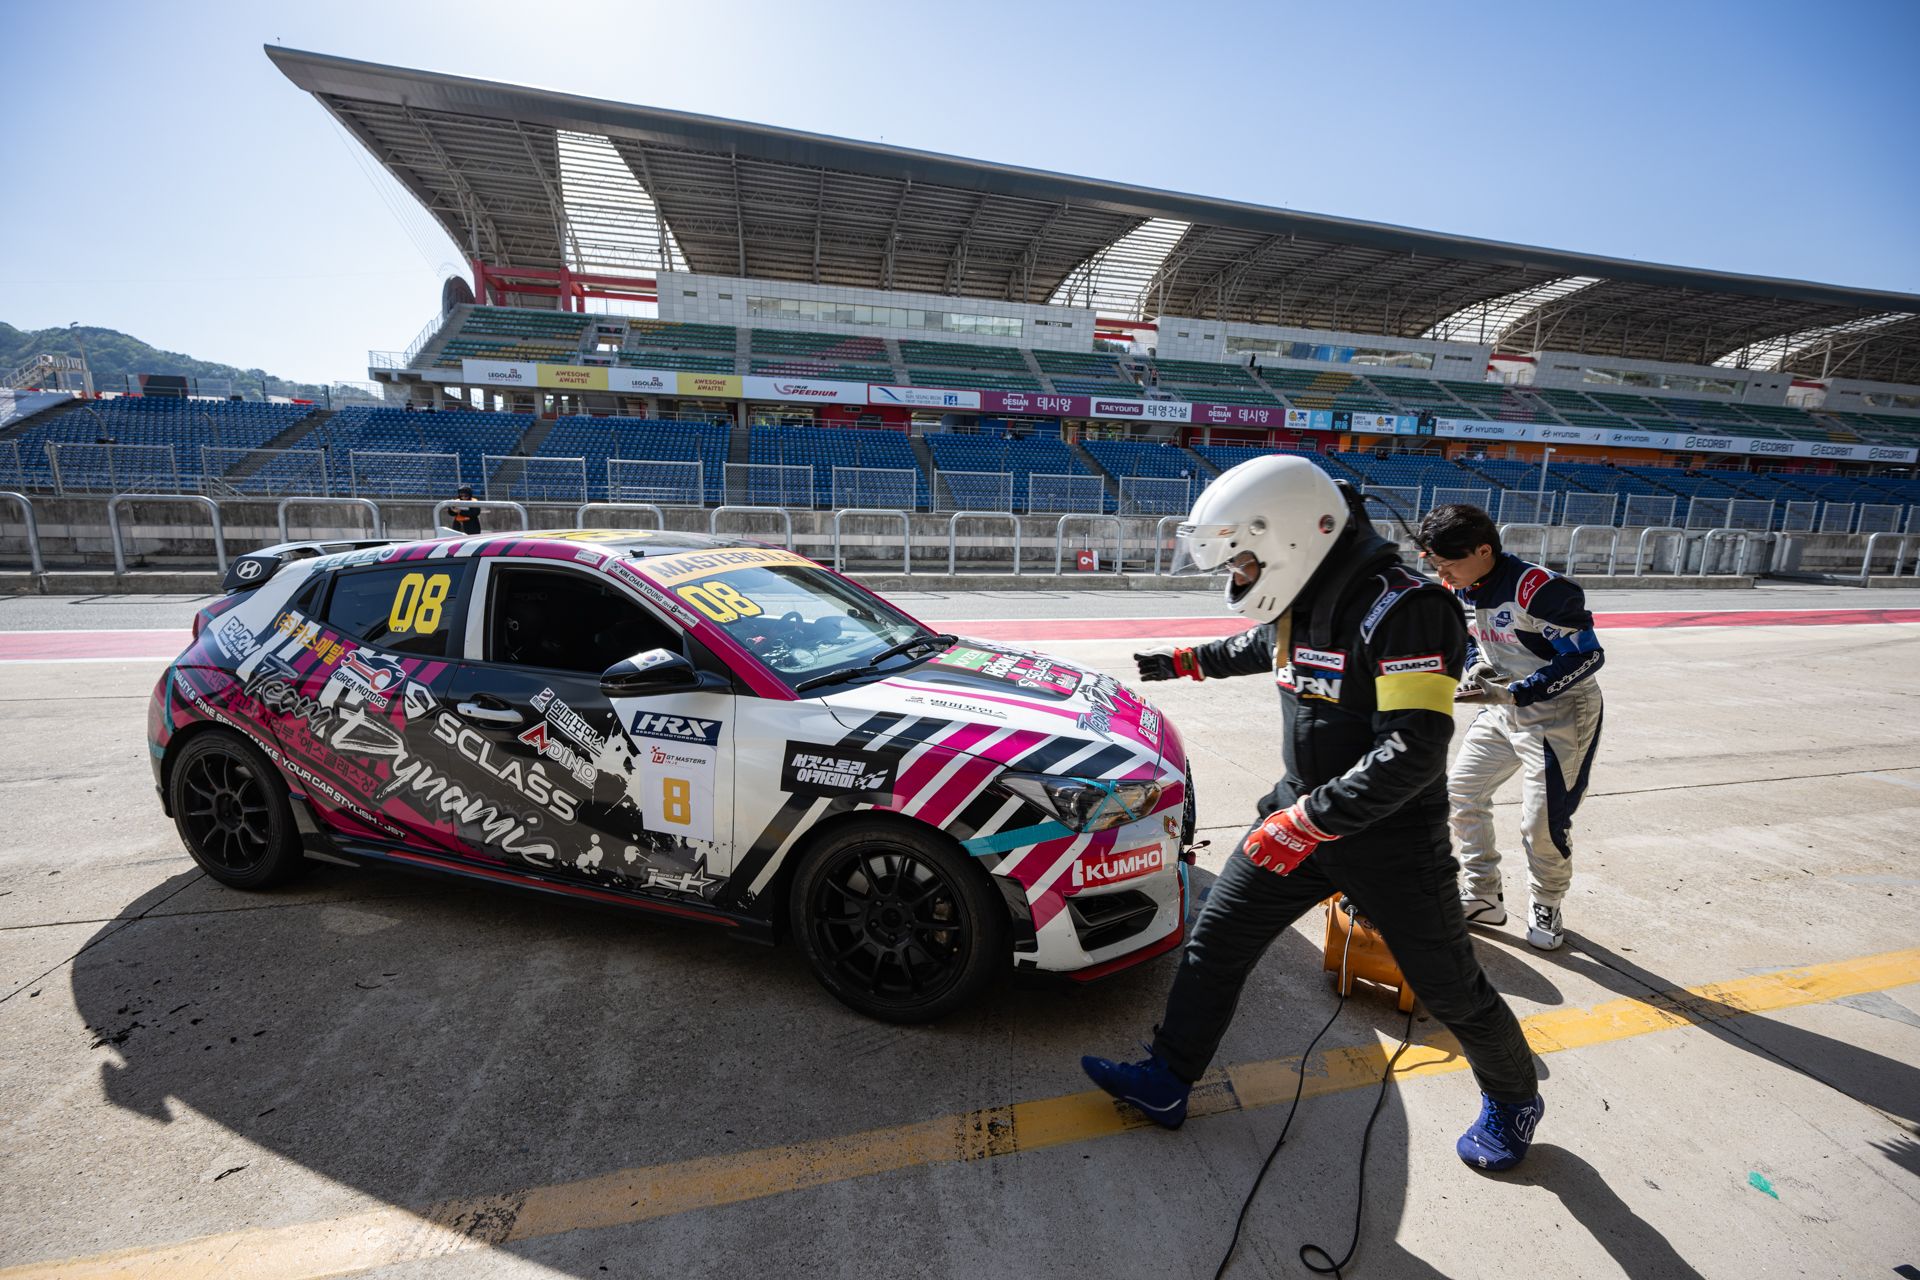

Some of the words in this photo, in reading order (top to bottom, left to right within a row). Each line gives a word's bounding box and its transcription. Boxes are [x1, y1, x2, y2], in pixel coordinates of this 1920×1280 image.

[488, 372, 522, 380] LEGOLAND
[780, 385, 838, 397] SPEEDIUM
[944, 395, 957, 405] 14
[1002, 398, 1028, 406] DESIAN
[1036, 397, 1072, 412] 데시앙
[1147, 405, 1187, 418] 태영건설
[1208, 410, 1231, 418] DESIAN
[1238, 409, 1269, 423] 데시앙
[1475, 426, 1504, 434] HYUNDAI
[1696, 438, 1732, 449] ECORBIT
[1760, 442, 1795, 453] ECORBIT
[1820, 445, 1852, 456] ECORBIT
[1877, 449, 1909, 460] ECORBIT
[650, 551, 760, 578] MASTERS
[618, 568, 629, 579] KIM
[628, 574, 645, 589] CHAN
[643, 585, 664, 602] YOUNG
[388, 572, 452, 635] 08
[675, 580, 764, 624] 08
[273, 611, 345, 666] (주)카스메탈
[1297, 651, 1341, 666] KUMHO
[1384, 658, 1440, 673] KUMHO
[244, 653, 333, 731] Team
[332, 669, 356, 690] KOREA
[354, 684, 389, 708] MOTORS
[636, 713, 716, 739] HRX
[195, 697, 216, 718] FINE
[281, 757, 313, 783] YOUR
[311, 776, 335, 800] CAR
[332, 791, 379, 826] STYLISH
[433, 712, 578, 822] SCLASS
[675, 755, 707, 765] MASTERS
[791, 753, 867, 775] 서킷스토리
[796, 768, 857, 789] 아카데미
[331, 707, 556, 868] Dynamic
[663, 776, 691, 826] 8
[1086, 850, 1161, 881] KUMHO
